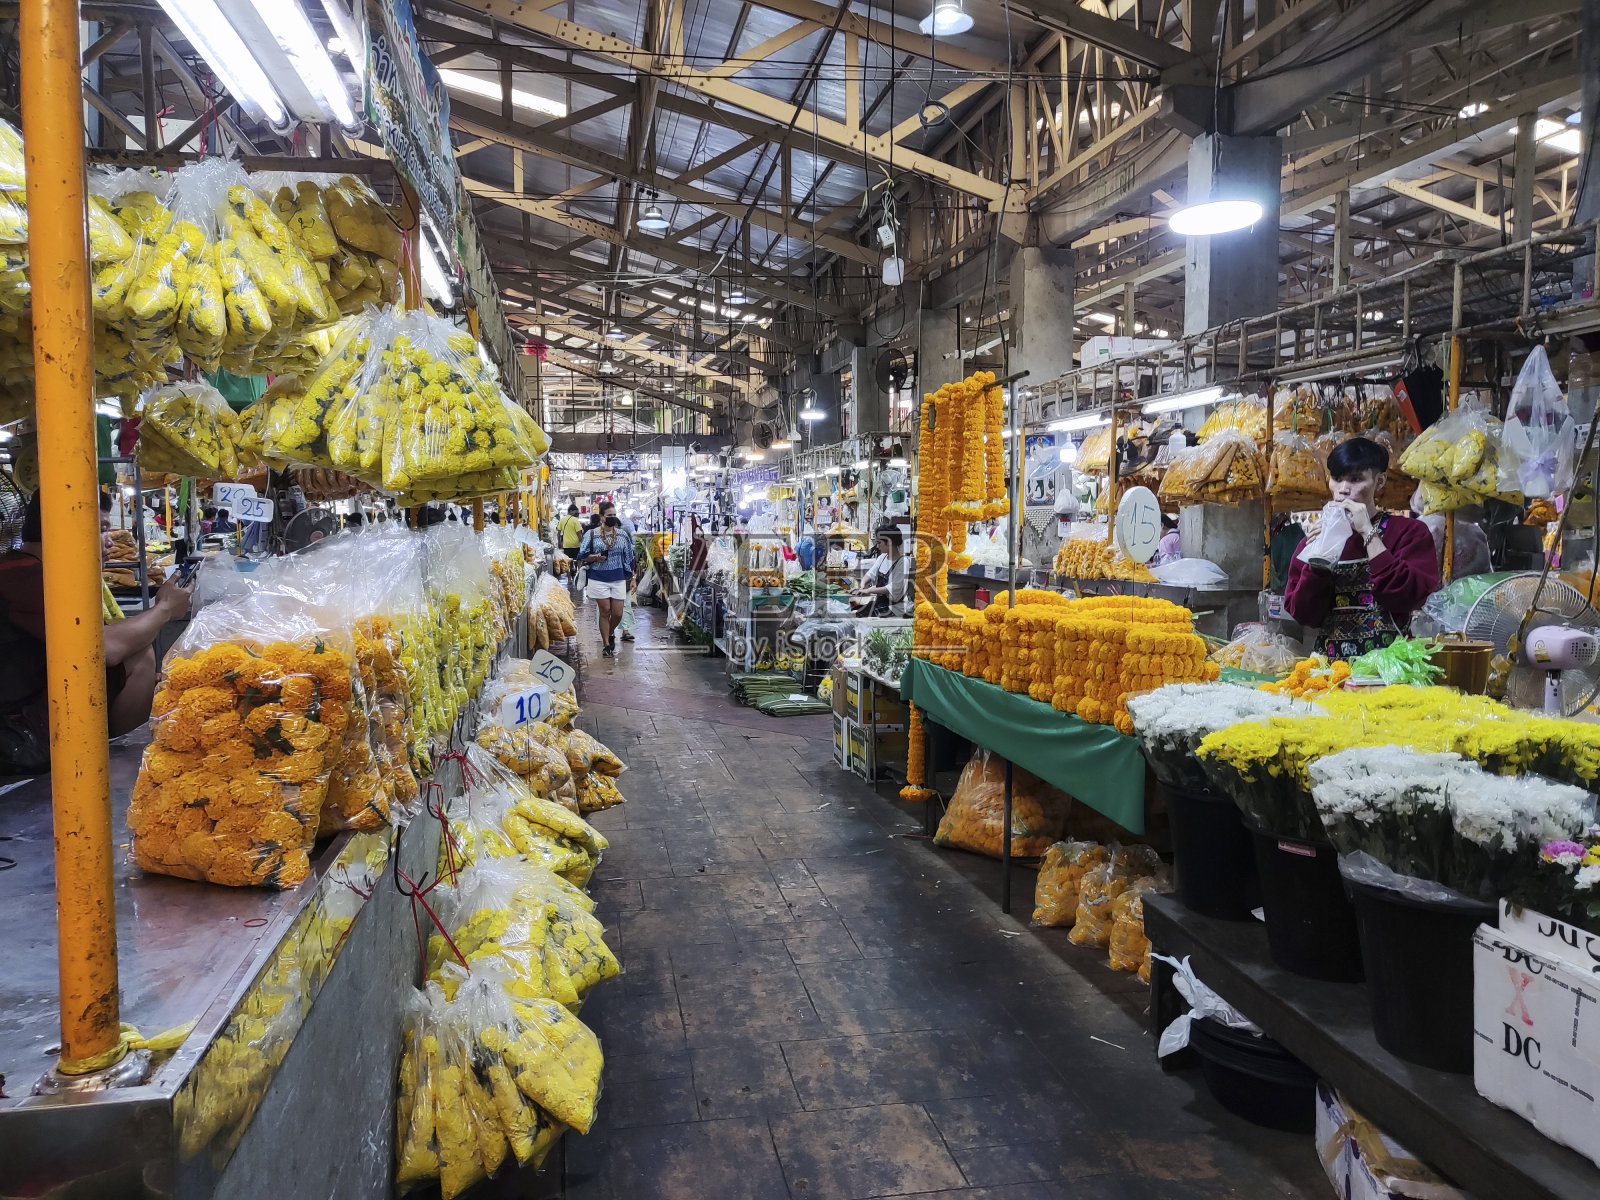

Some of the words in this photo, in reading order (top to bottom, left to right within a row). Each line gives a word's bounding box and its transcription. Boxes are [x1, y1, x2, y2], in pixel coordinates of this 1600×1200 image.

[241, 498, 266, 518] 25
[1130, 501, 1156, 547] 15
[535, 659, 565, 684] 10
[515, 692, 541, 725] 10
[1502, 1021, 1541, 1070] DC
